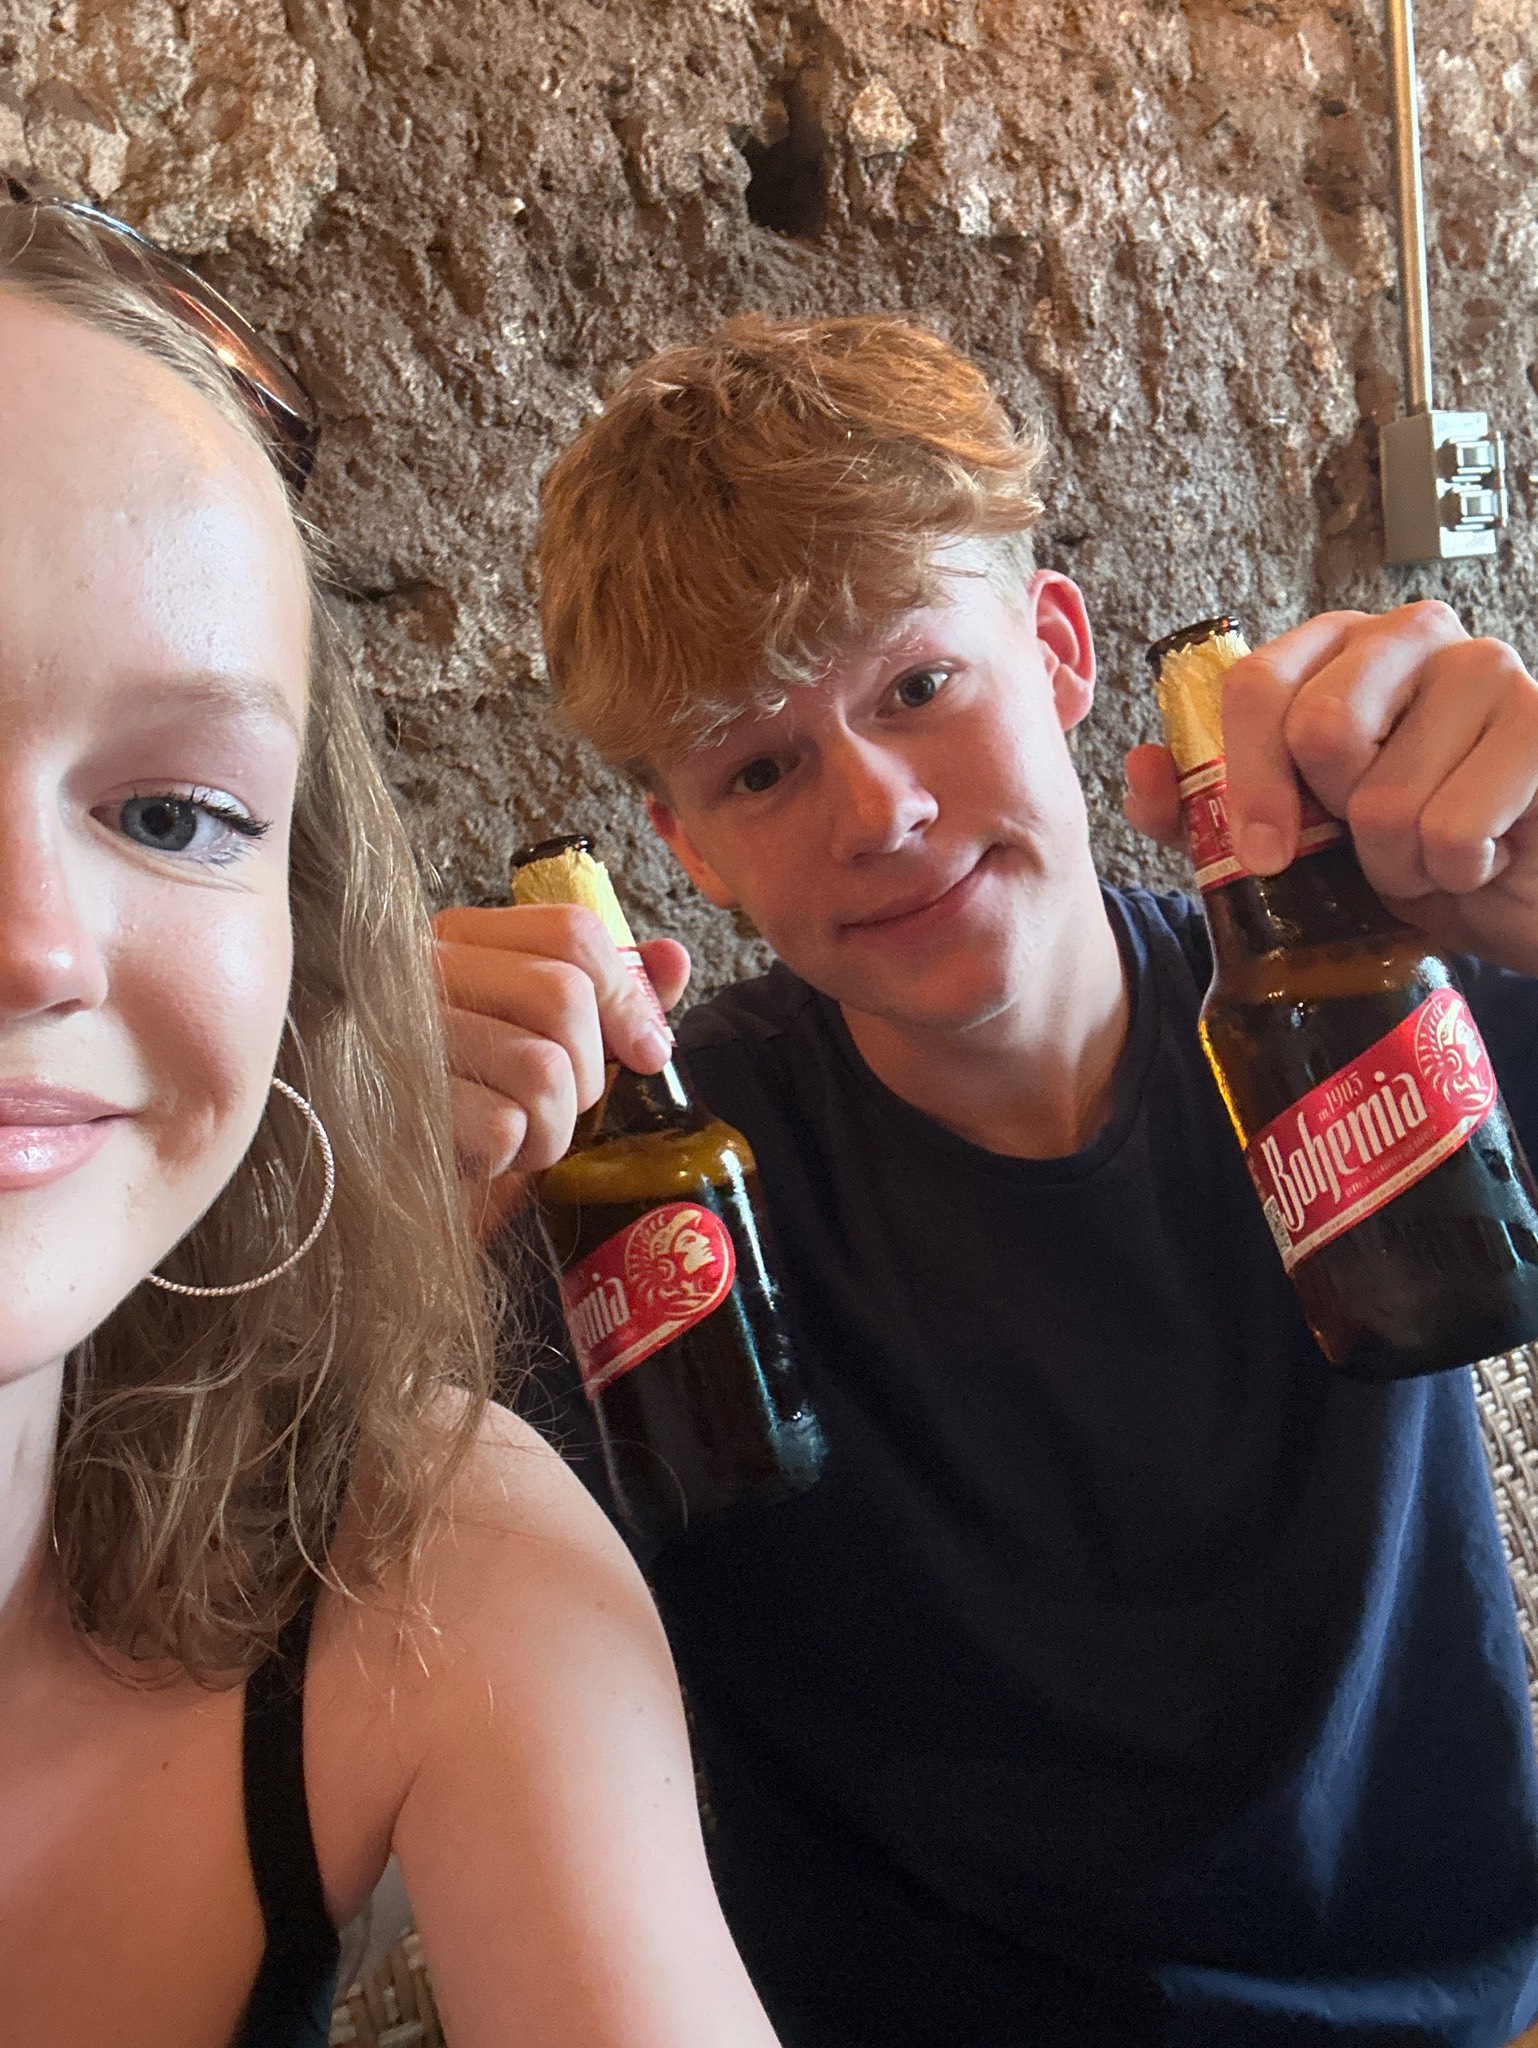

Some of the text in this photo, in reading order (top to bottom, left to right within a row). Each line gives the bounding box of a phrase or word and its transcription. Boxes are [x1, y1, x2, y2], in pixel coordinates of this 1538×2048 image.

[1325, 1071, 1363, 1115] 1905
[1260, 1070, 1428, 1233] Bohemia
[572, 1272, 631, 1348] mia
